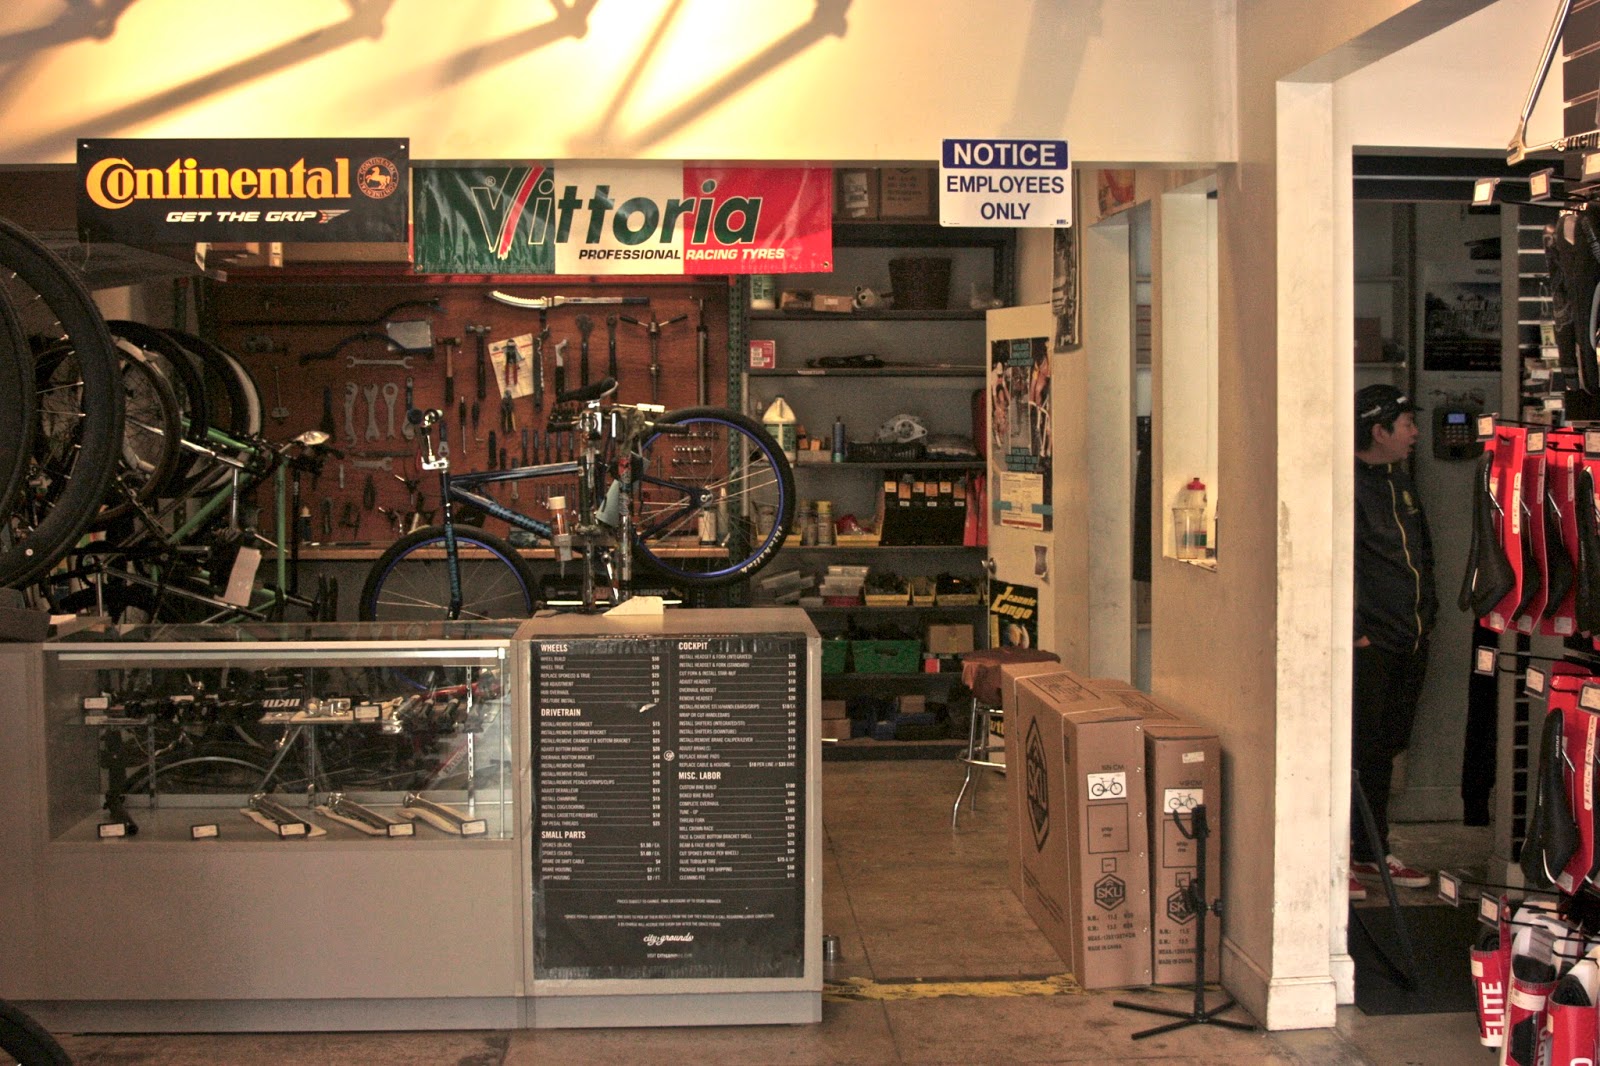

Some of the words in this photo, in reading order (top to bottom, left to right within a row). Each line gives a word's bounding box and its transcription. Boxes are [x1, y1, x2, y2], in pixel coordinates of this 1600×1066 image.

[953, 144, 1057, 166] NOTICE
[86, 157, 351, 209] Continental
[947, 176, 1064, 193] EMPLOYEES
[166, 211, 212, 222] GET
[217, 211, 260, 222] THE
[266, 211, 317, 222] GRIP
[471, 165, 763, 259] Vittoria
[981, 203, 1030, 220] ONLY
[579, 250, 681, 260] PROFESSIONAL
[686, 249, 737, 260] RACING
[742, 248, 785, 260] TYRES
[991, 594, 1033, 619] Longo
[541, 644, 568, 652] WHEELS
[678, 642, 708, 650] COCKPIT
[1096, 885, 1122, 898] SKU
[1482, 980, 1505, 1039] ELITE
